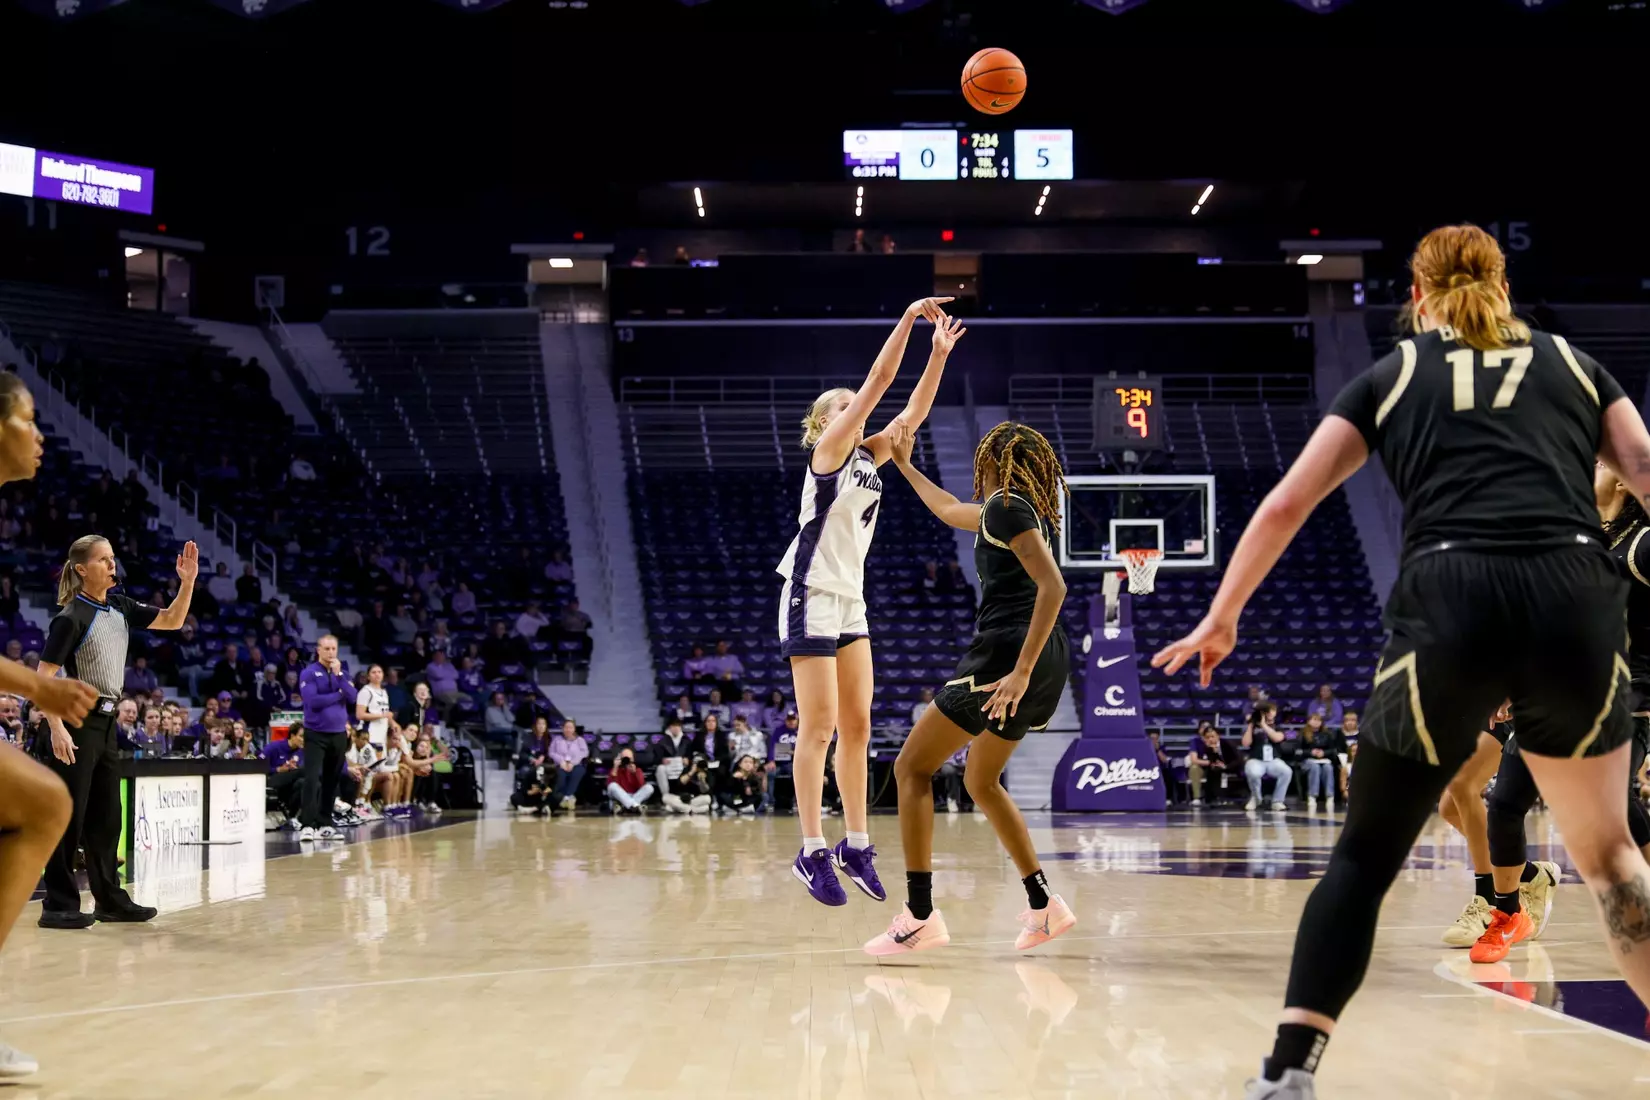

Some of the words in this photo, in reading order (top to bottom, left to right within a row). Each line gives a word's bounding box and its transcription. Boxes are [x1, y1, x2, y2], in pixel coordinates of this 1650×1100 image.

[971, 133, 999, 148] 7:34
[921, 147, 935, 168] 0
[961, 157, 968, 167] 4
[1001, 157, 1009, 167] 4
[1036, 147, 1050, 168] 5
[878, 166, 897, 177] PM
[345, 226, 391, 256] 12
[617, 328, 634, 343] 13
[1292, 324, 1309, 340] 14
[1445, 346, 1534, 413] 17
[1115, 388, 1152, 407] 7:34
[1127, 408, 1148, 438] 9
[860, 499, 879, 529] 4
[1094, 706, 1136, 717] Channel
[1072, 757, 1160, 791] Dillons
[156, 782, 199, 809] Ascension
[156, 820, 170, 847] Via
[171, 817, 200, 847] Christi
